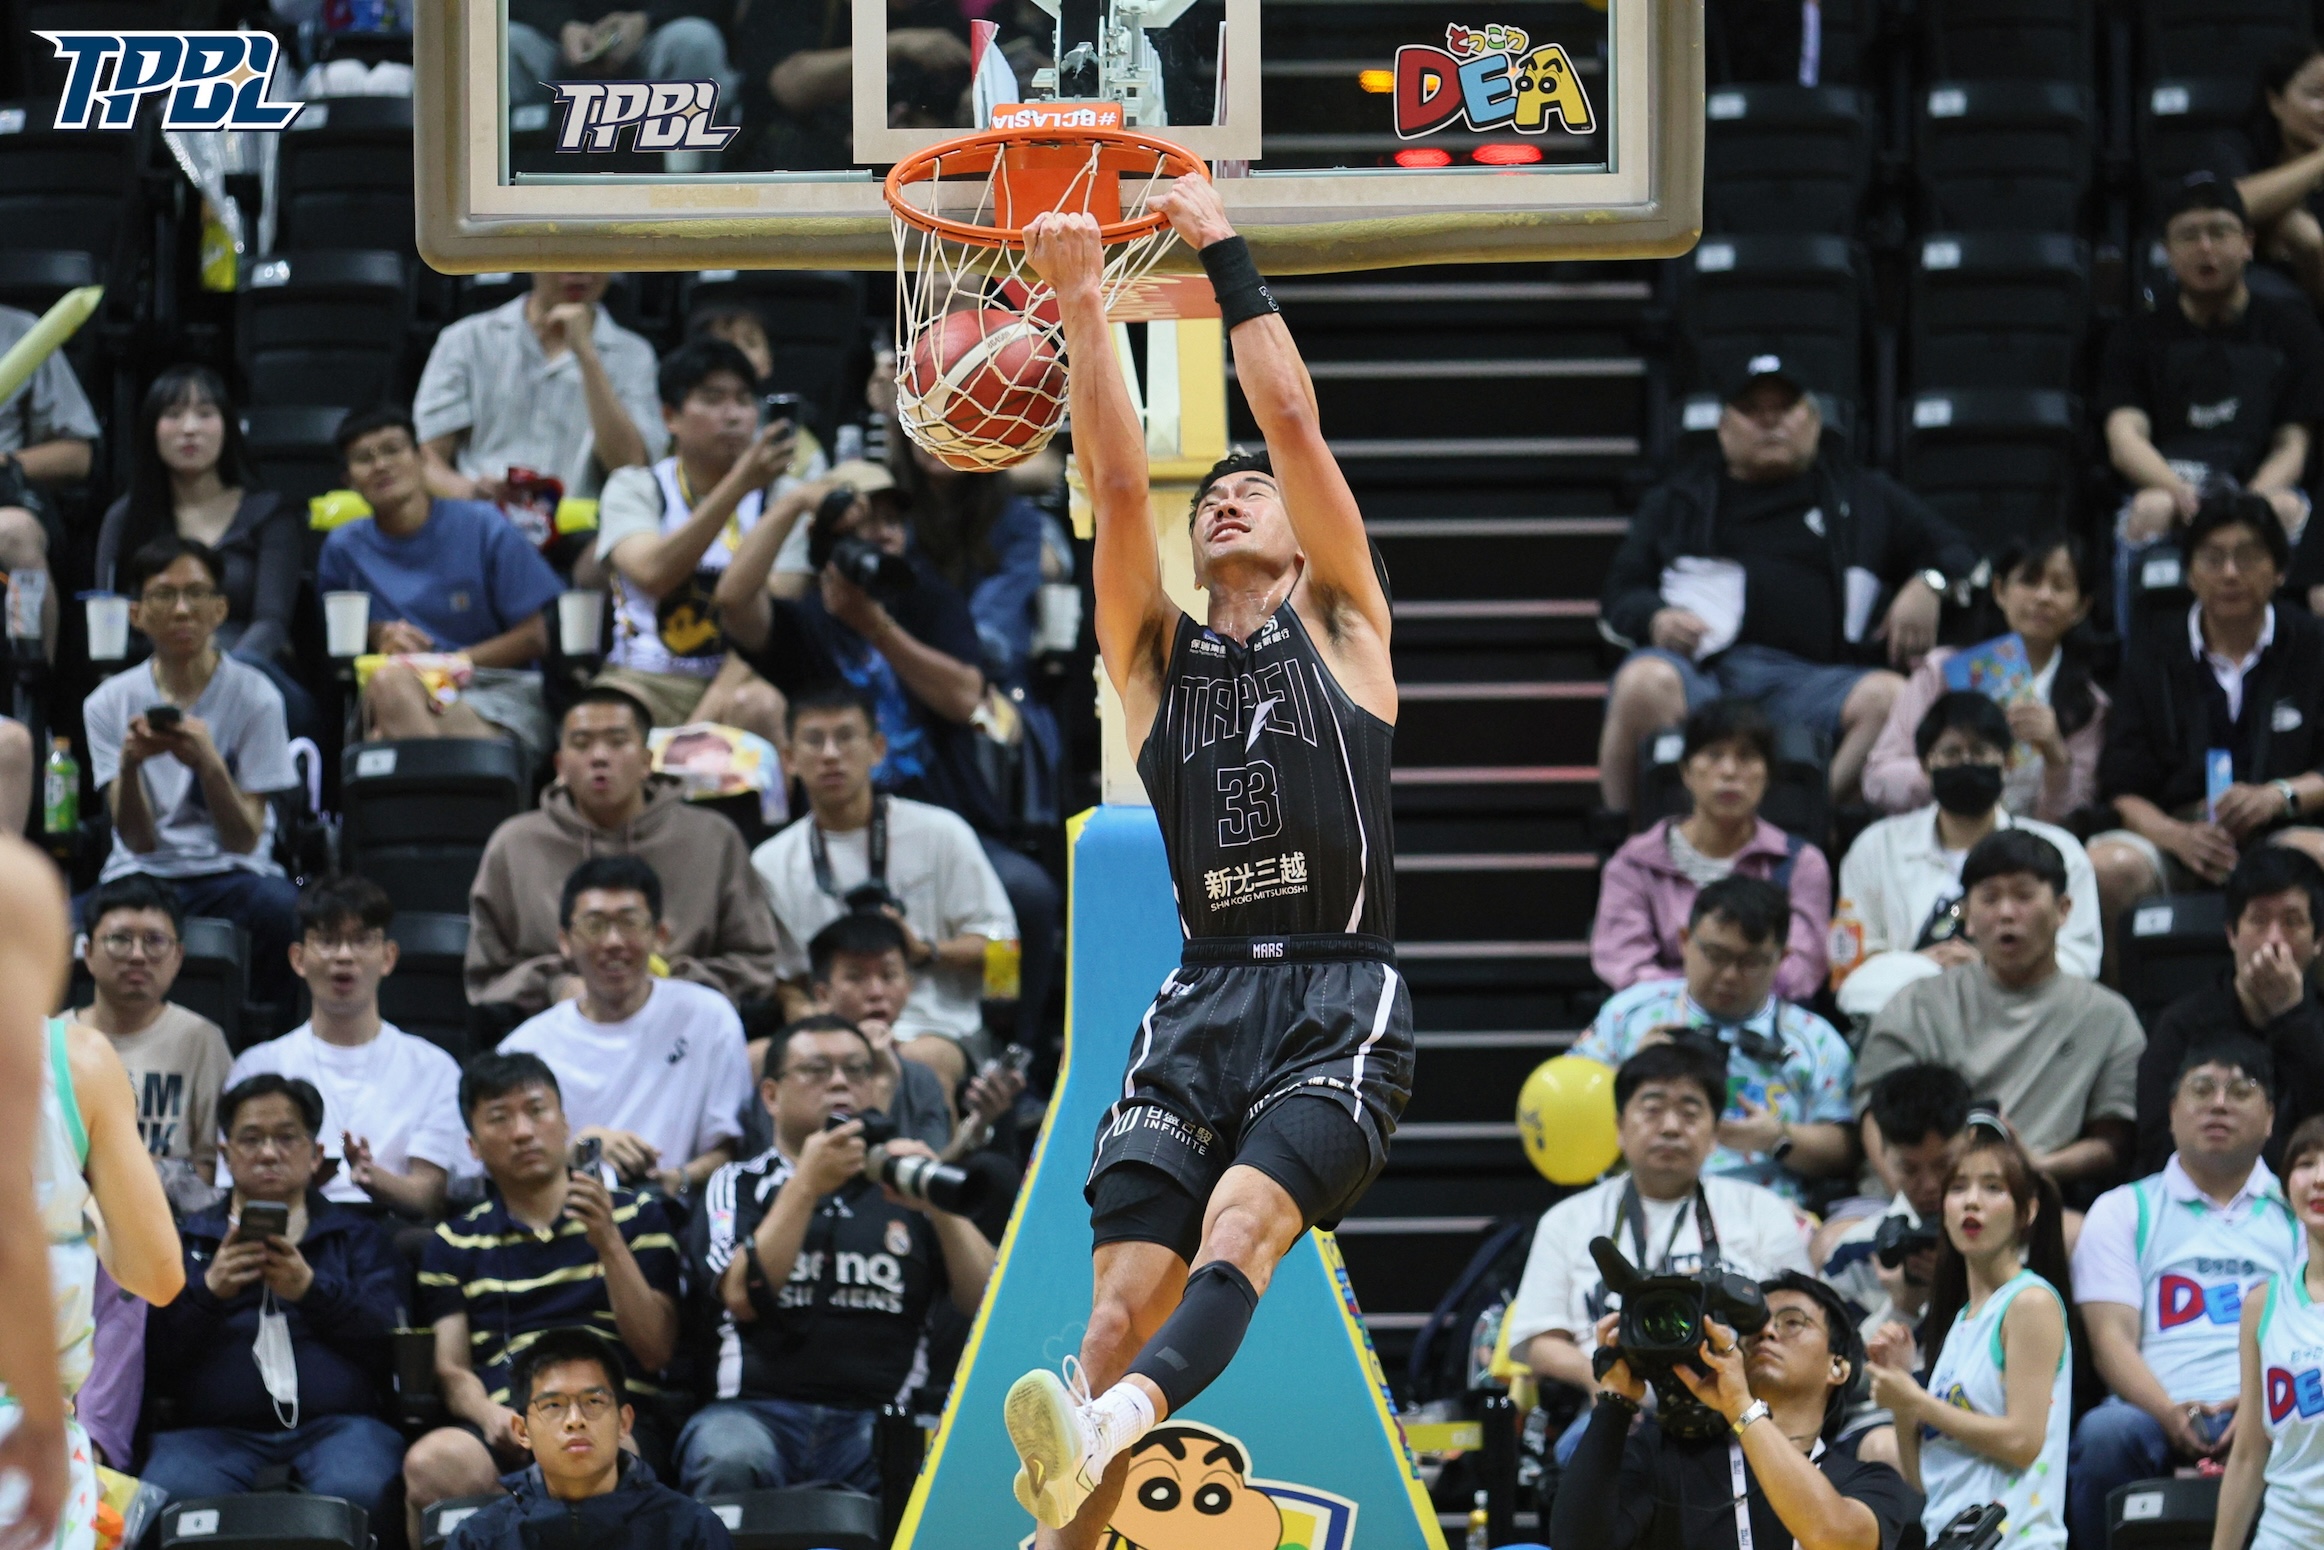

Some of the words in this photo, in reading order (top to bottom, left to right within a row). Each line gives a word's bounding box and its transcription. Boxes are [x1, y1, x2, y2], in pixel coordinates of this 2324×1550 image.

[543, 79, 740, 153] TPBL
[1396, 45, 1593, 135] DEA
[992, 108, 1117, 129] #BCLASIA
[1217, 760, 1283, 847] 33
[1204, 851, 1307, 900] 新光三越
[1253, 885, 1308, 901] MITSUKOSHI
[1252, 942, 1284, 959] MARS
[1143, 1118, 1207, 1156] INFINITE
[2159, 1274, 2241, 1331] DE
[2267, 1367, 2324, 1425] DE
